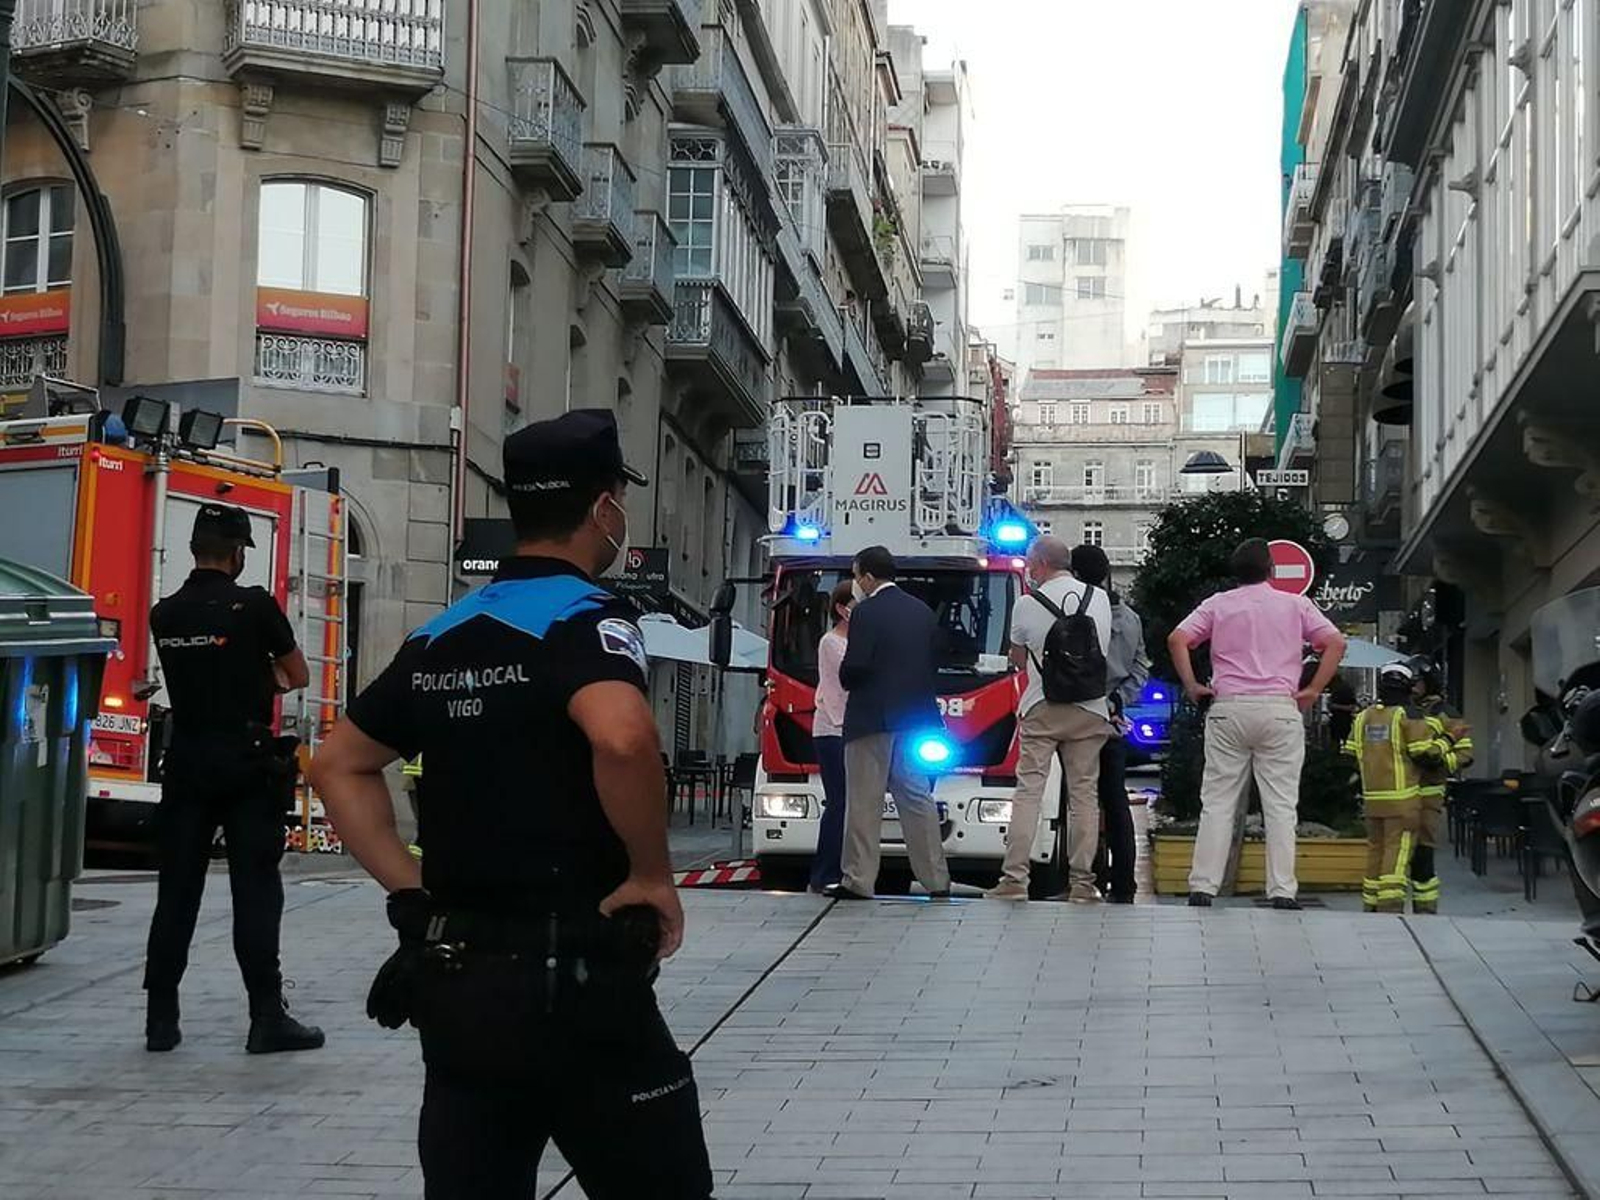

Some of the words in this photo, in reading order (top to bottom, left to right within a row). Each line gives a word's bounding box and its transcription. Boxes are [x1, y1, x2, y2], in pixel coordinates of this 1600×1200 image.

[835, 499, 907, 512] MAGIRUS
[475, 664, 530, 687] LOCAL
[447, 698, 482, 718] VIGO
